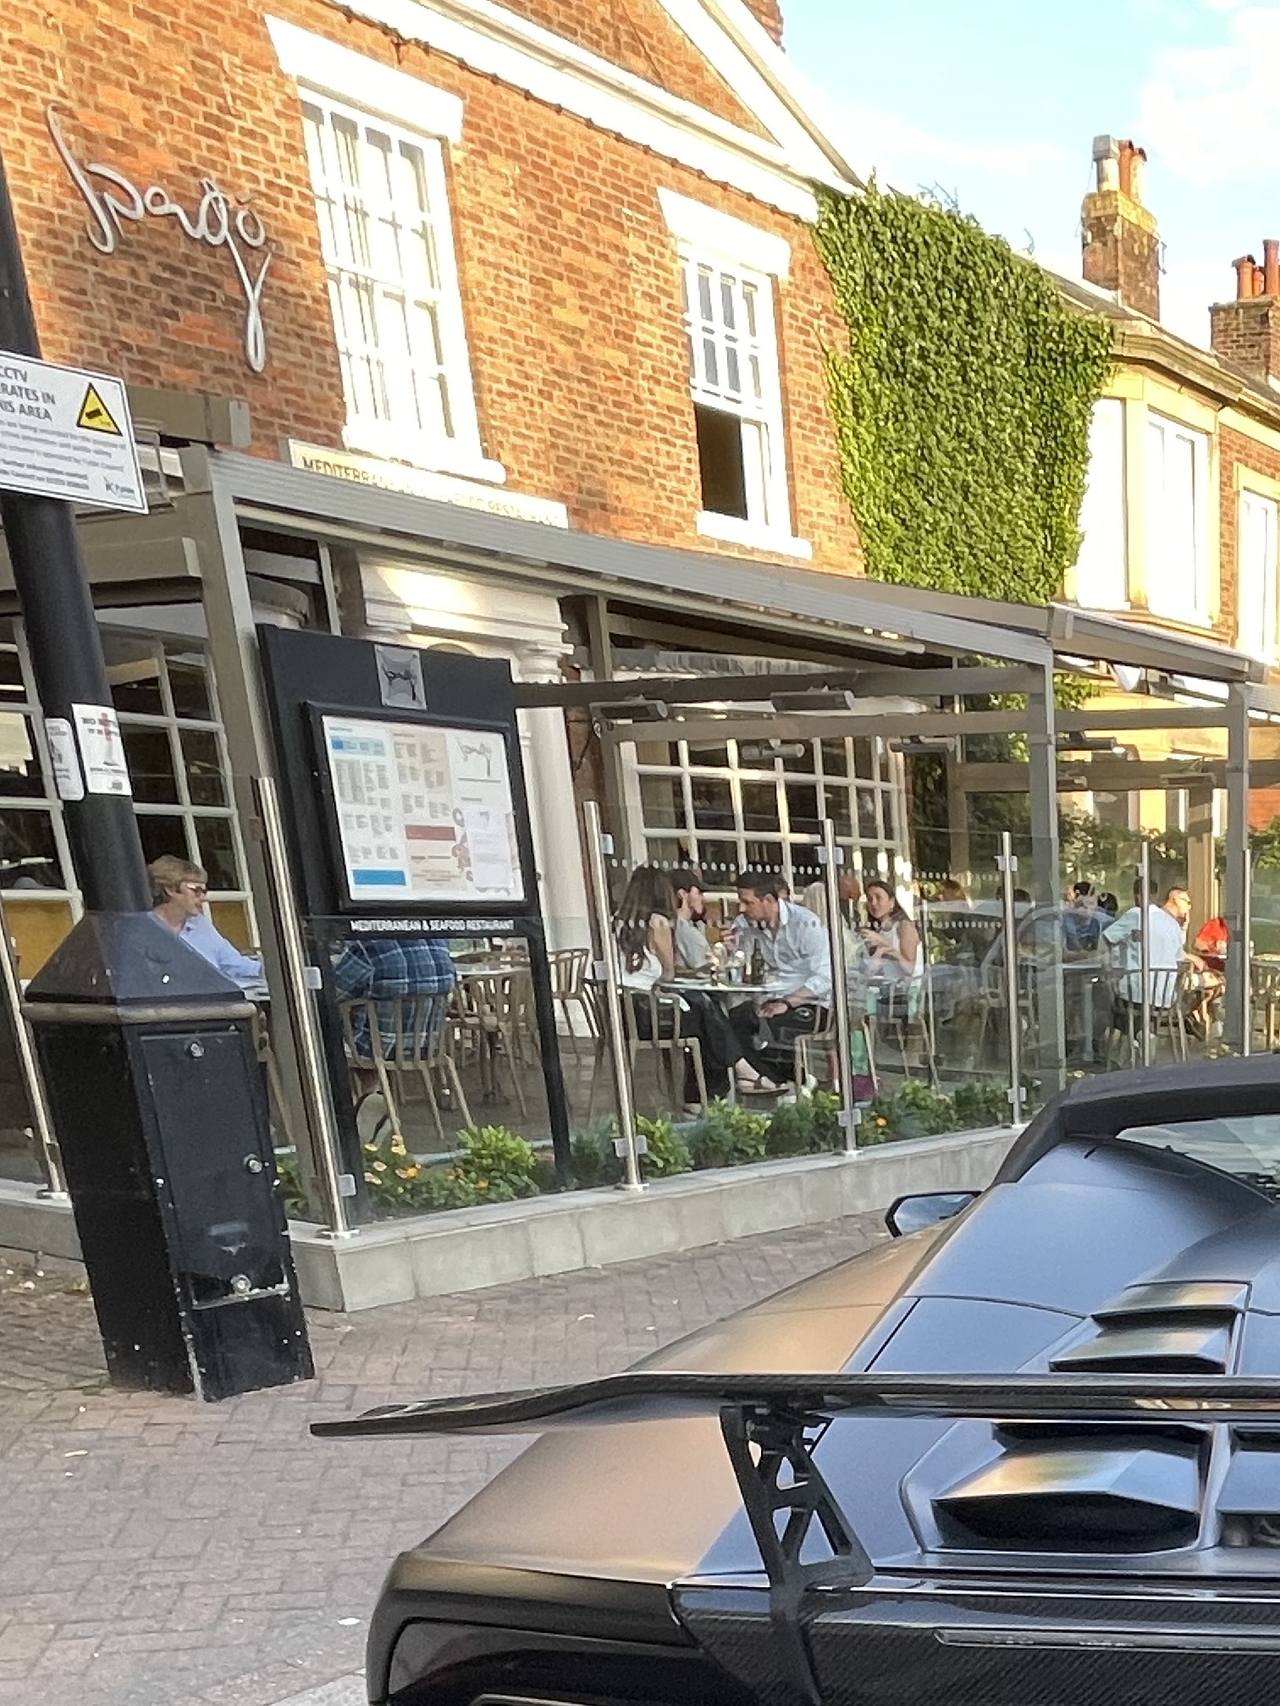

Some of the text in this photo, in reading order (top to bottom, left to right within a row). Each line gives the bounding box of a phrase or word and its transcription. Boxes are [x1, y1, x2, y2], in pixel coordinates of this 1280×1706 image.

[0, 382, 56, 405] RATES IN
[19, 403, 53, 421] AREA
